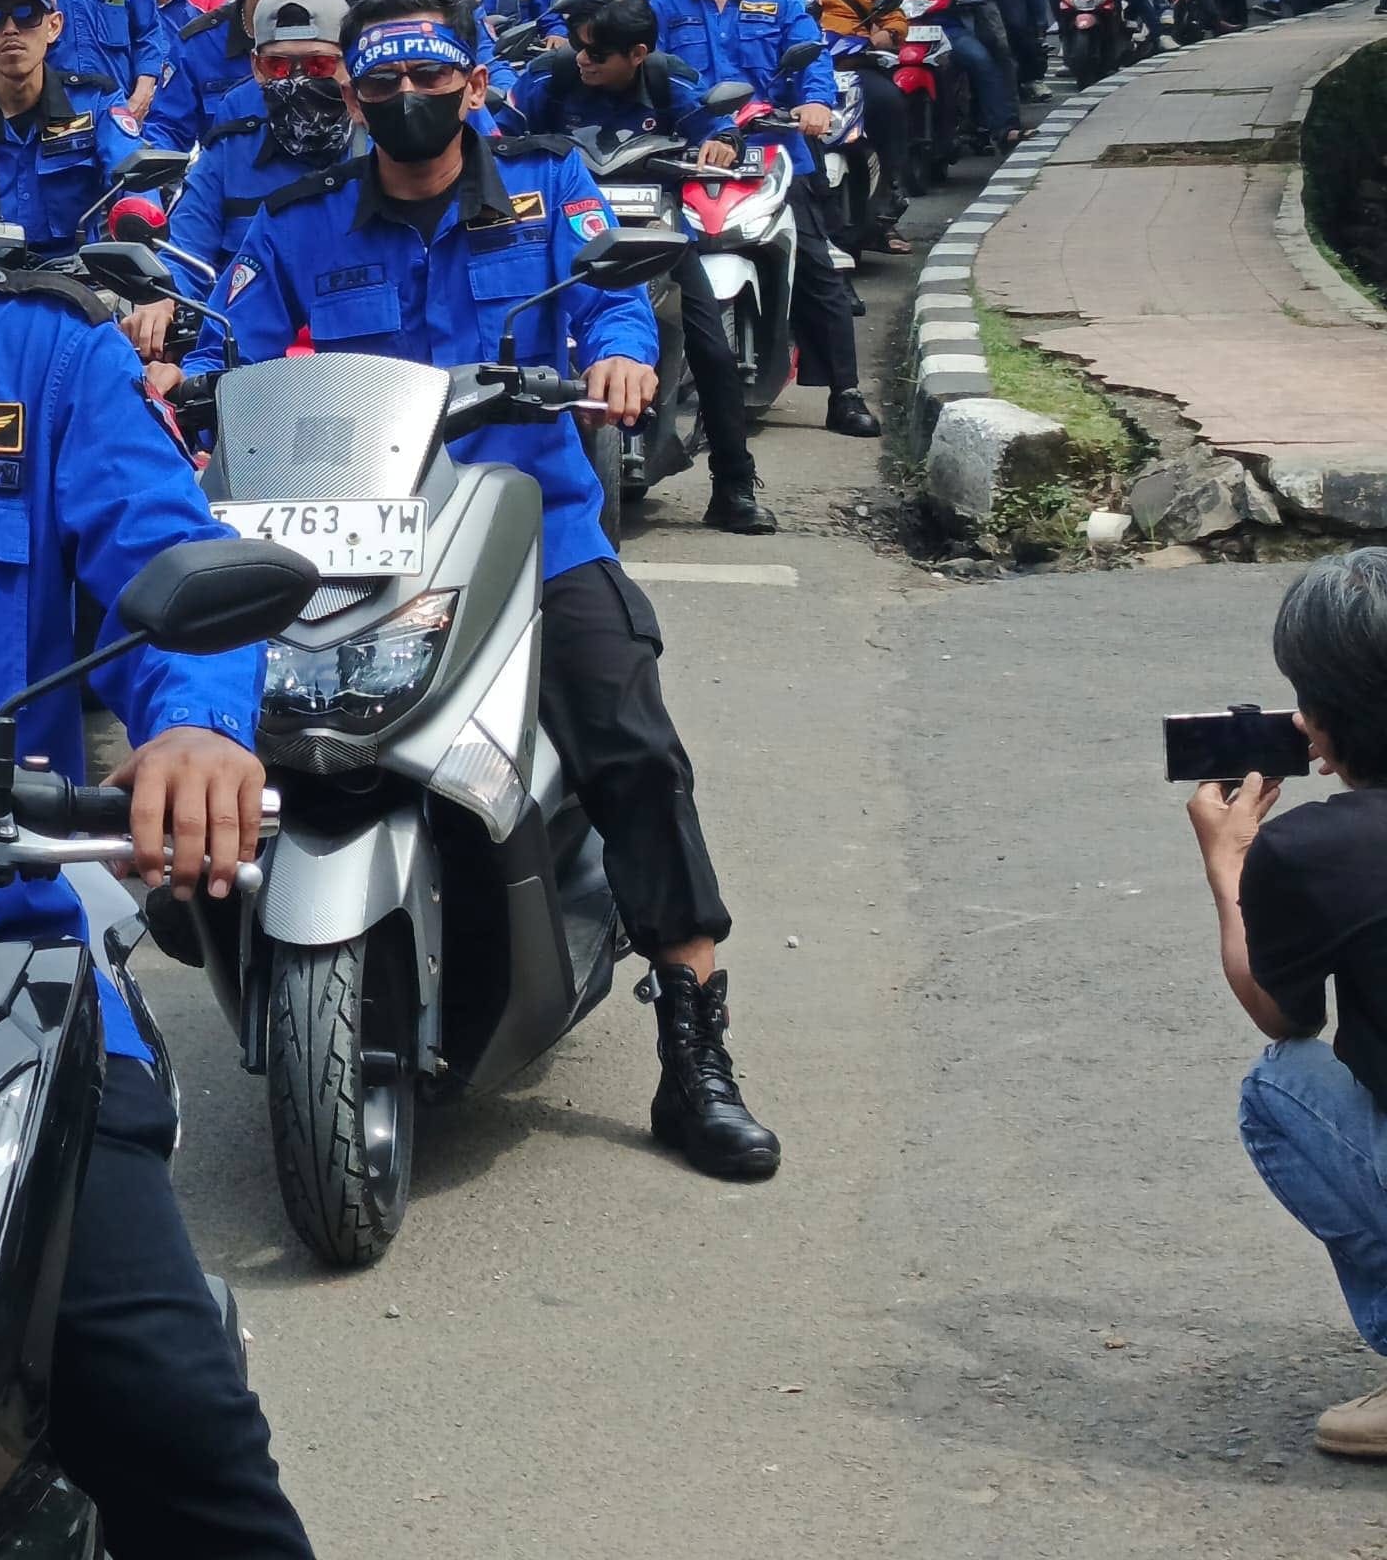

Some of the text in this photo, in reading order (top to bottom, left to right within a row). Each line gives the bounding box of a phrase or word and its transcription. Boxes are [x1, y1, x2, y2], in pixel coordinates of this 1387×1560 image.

[364, 40, 399, 63] SPSI
[257, 505, 340, 536] 4763
[376, 504, 420, 535] YW
